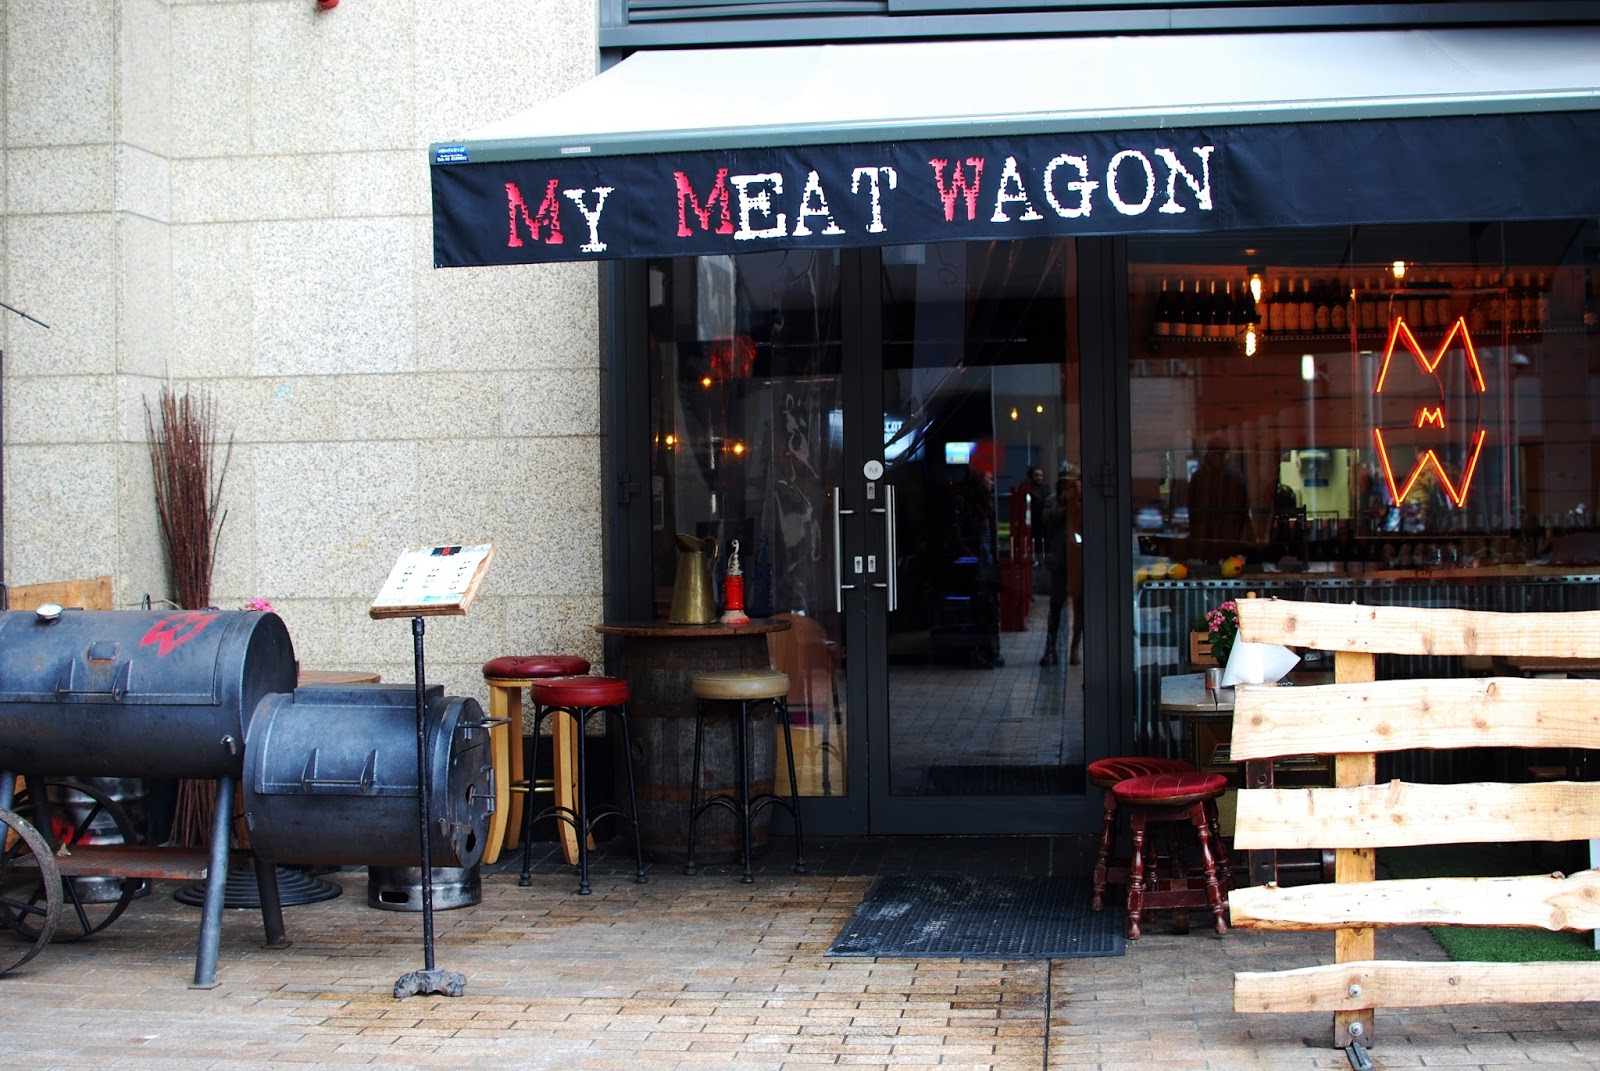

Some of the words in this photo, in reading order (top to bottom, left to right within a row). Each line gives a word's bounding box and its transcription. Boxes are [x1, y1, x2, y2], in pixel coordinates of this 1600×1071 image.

[504, 178, 616, 254] MY
[673, 167, 898, 241] MEAT
[928, 145, 1215, 222] WAGON
[1376, 316, 1486, 393] M
